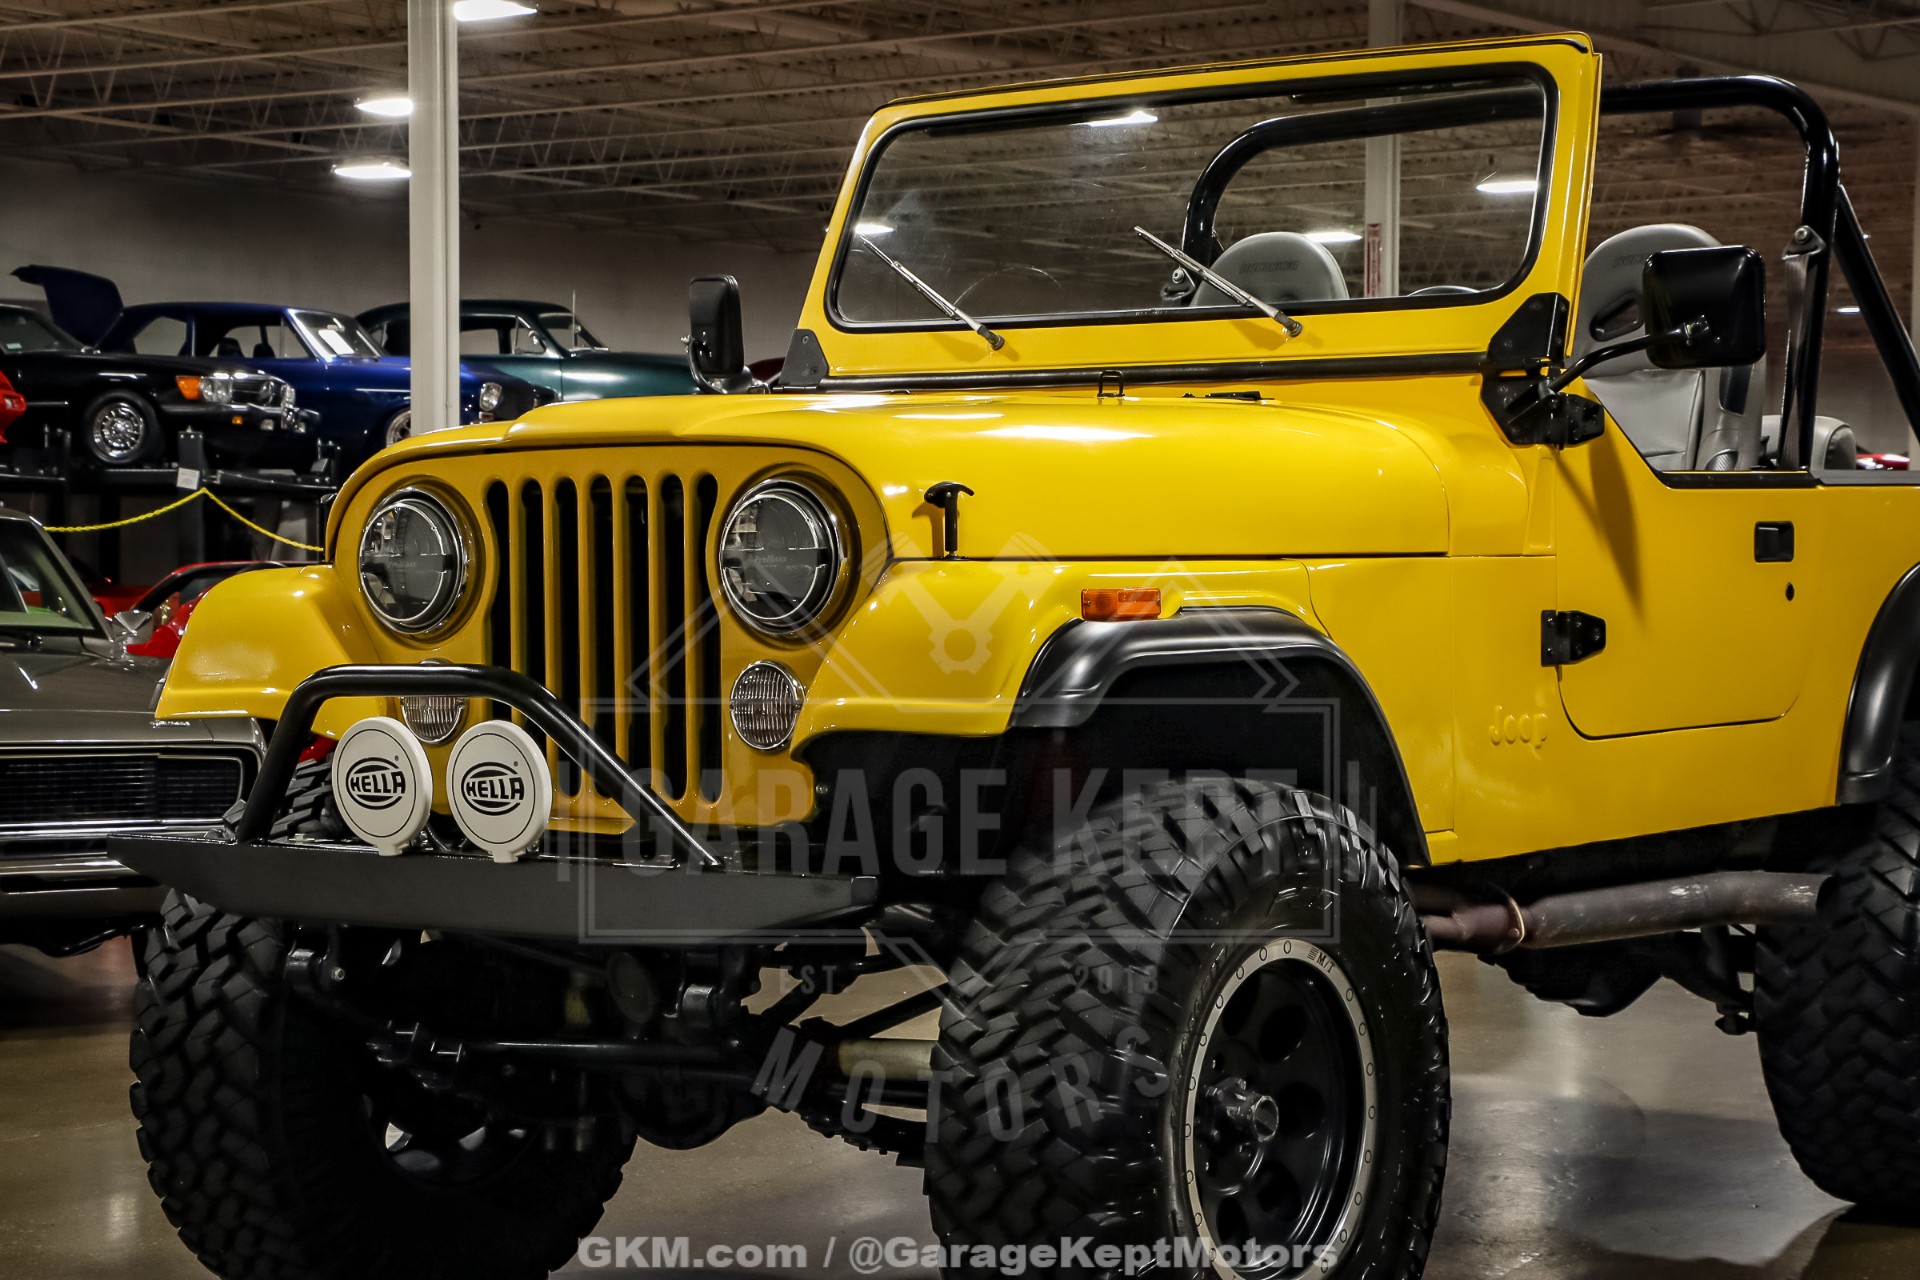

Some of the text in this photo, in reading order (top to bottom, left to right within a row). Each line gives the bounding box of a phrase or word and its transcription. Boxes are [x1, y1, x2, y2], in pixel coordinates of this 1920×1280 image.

[349, 769, 406, 795] HELLA
[465, 776, 525, 801] HELLA
[1316, 951, 1336, 974] M/T
